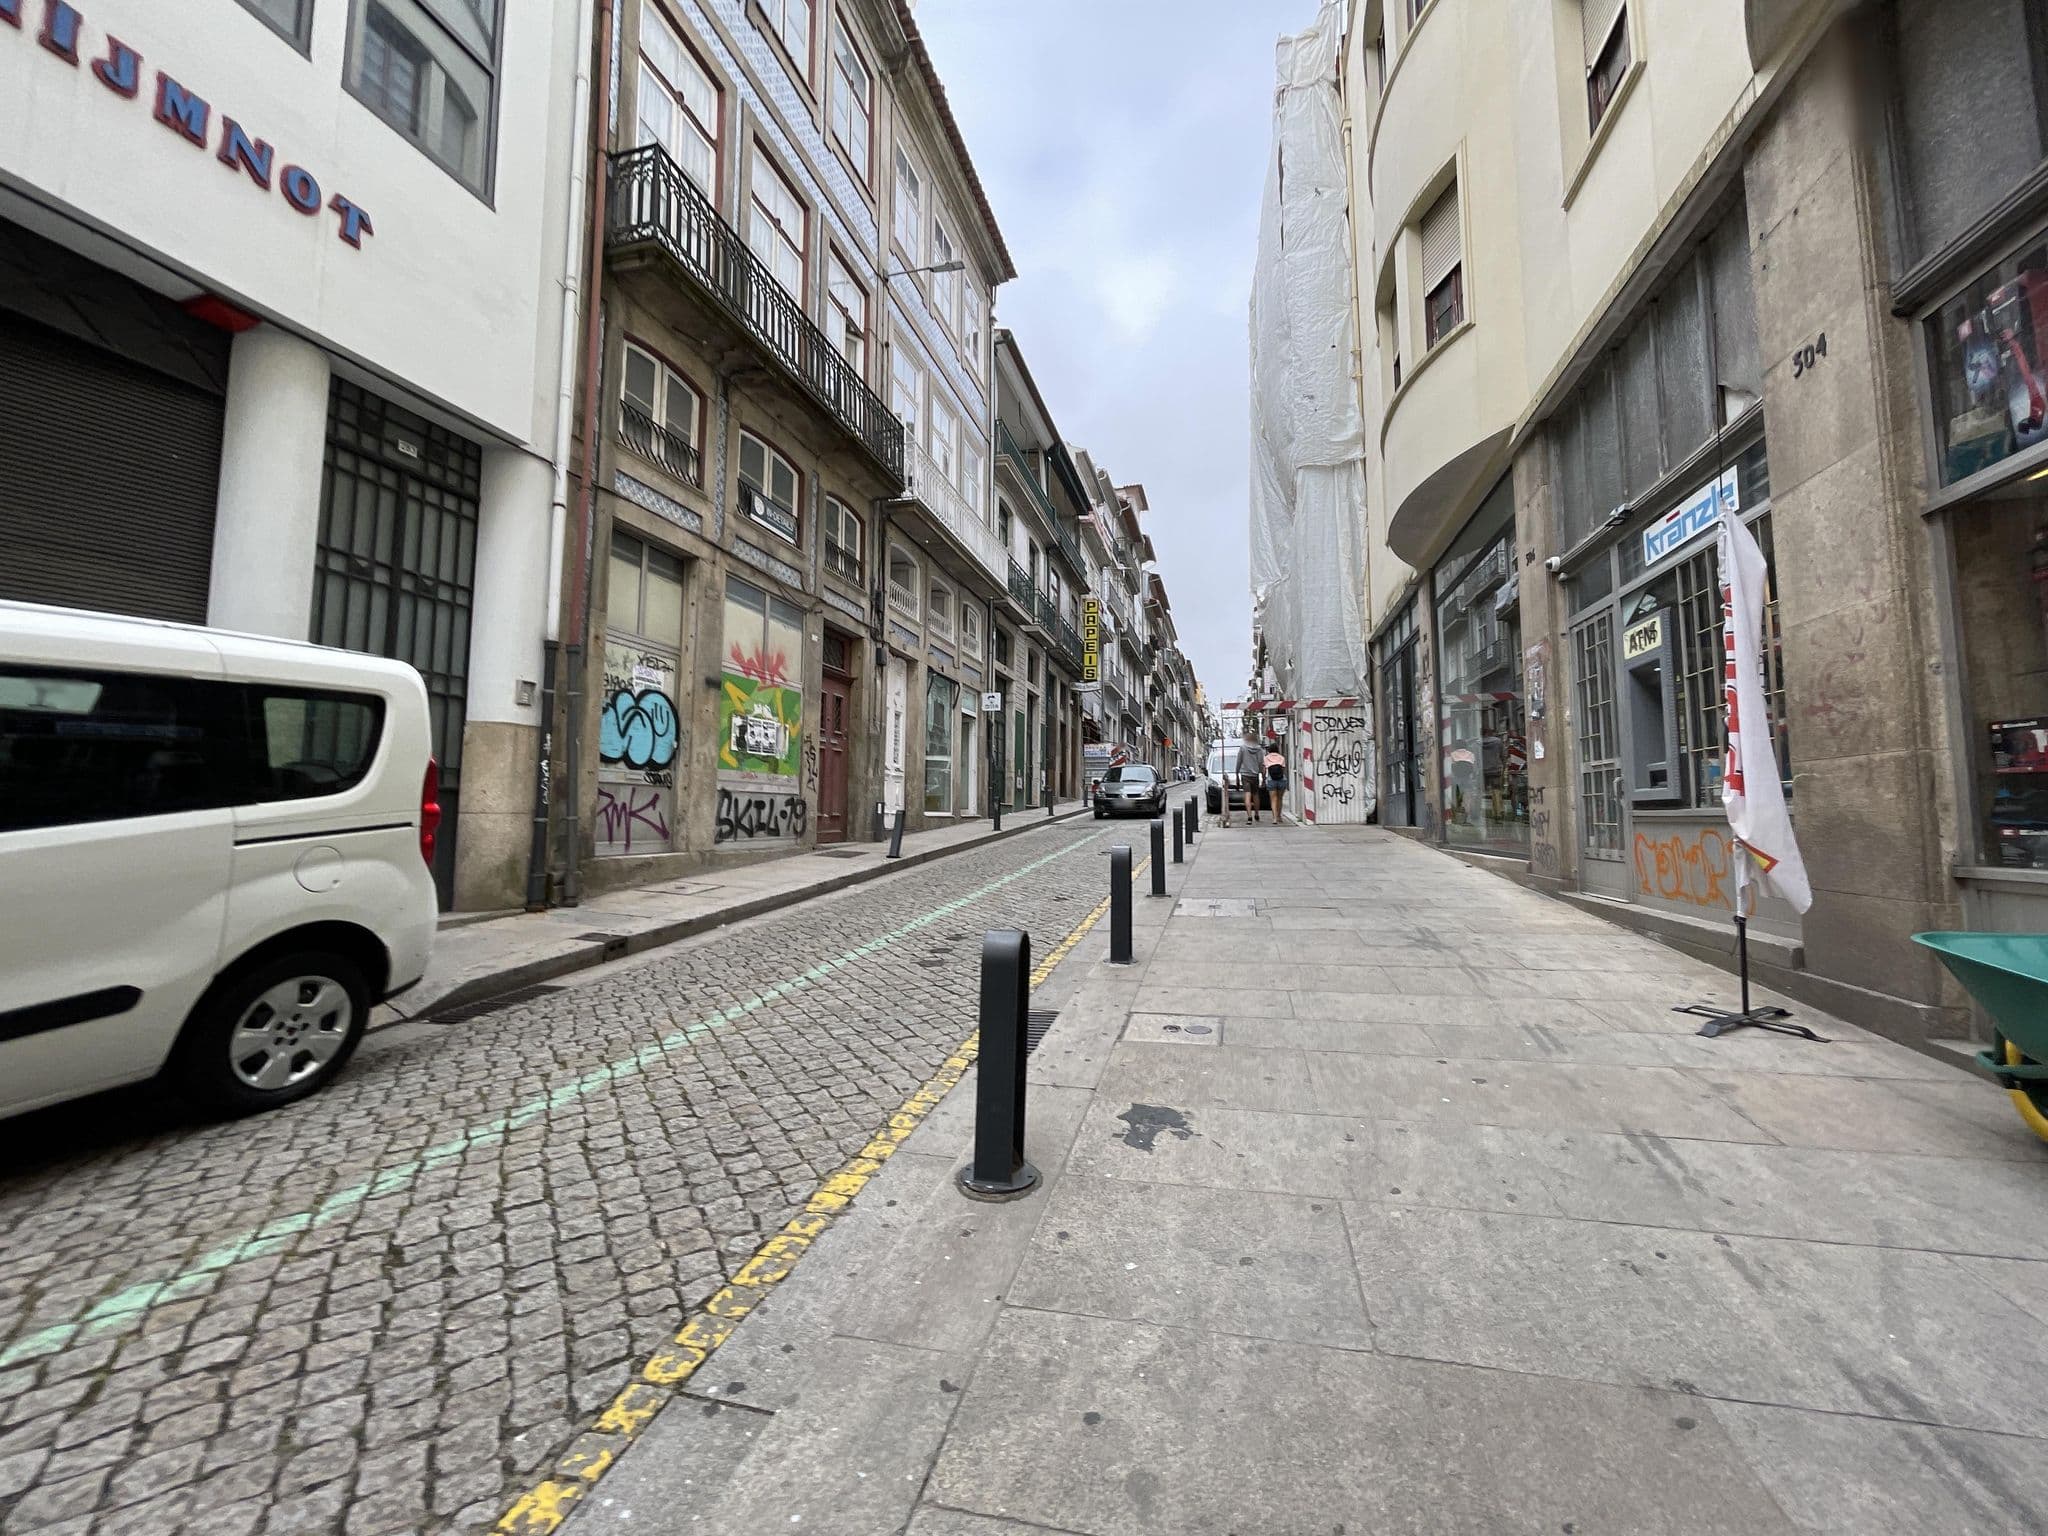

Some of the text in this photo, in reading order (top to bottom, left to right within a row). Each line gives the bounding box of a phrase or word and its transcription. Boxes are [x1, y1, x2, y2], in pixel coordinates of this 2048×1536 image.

[0, 0, 374, 250] IJMNOT
[1792, 332, 1827, 379] 504
[1085, 602, 1096, 679] PAPEIS
